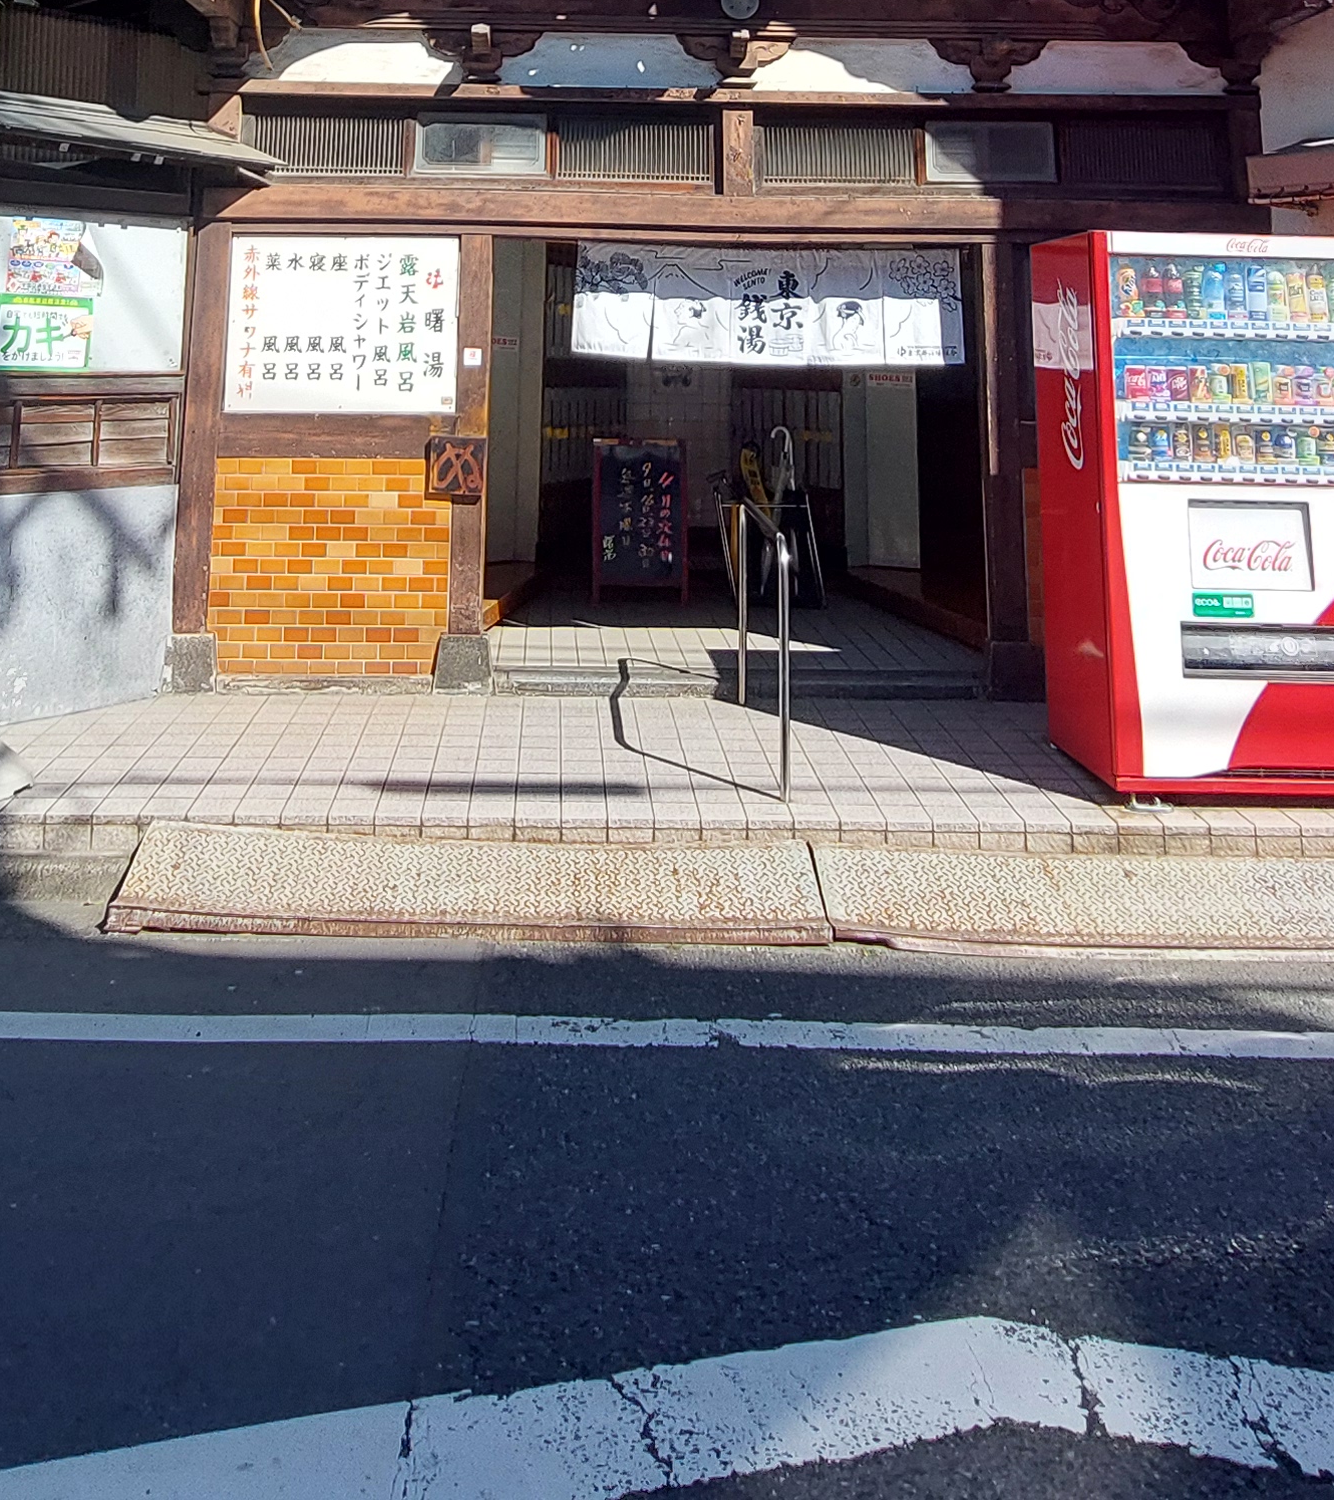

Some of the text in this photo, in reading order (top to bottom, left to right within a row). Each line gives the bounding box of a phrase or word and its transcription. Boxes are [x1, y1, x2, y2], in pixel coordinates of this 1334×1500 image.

[733, 268, 772, 287] WELCOME!
[742, 277, 765, 290] SENTO
[770, 270, 804, 330] 東京
[395, 254, 420, 393] 露天岩風呂
[423, 308, 445, 378] 曙湯
[734, 293, 767, 354] 銭湯
[1057, 278, 1084, 470] Coca-Cola
[1202, 539, 1296, 572] Coca-Cola
